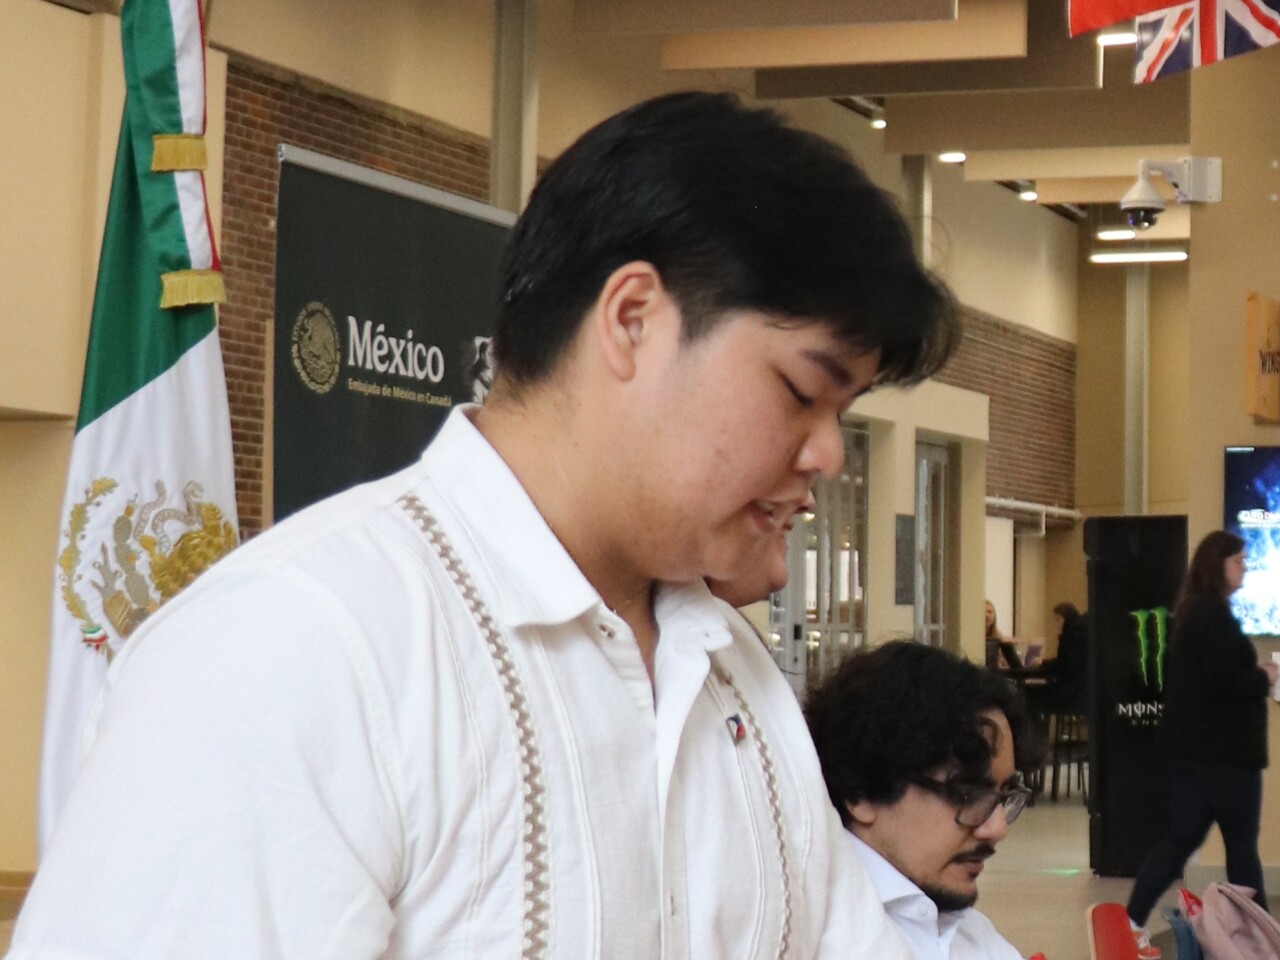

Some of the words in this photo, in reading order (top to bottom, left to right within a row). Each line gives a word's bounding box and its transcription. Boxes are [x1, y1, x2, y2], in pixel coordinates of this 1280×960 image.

[347, 316, 445, 383] México
[348, 378, 381, 396] Embajada
[382, 384, 392, 396] de
[393, 386, 416, 400] México
[417, 393, 425, 402] en
